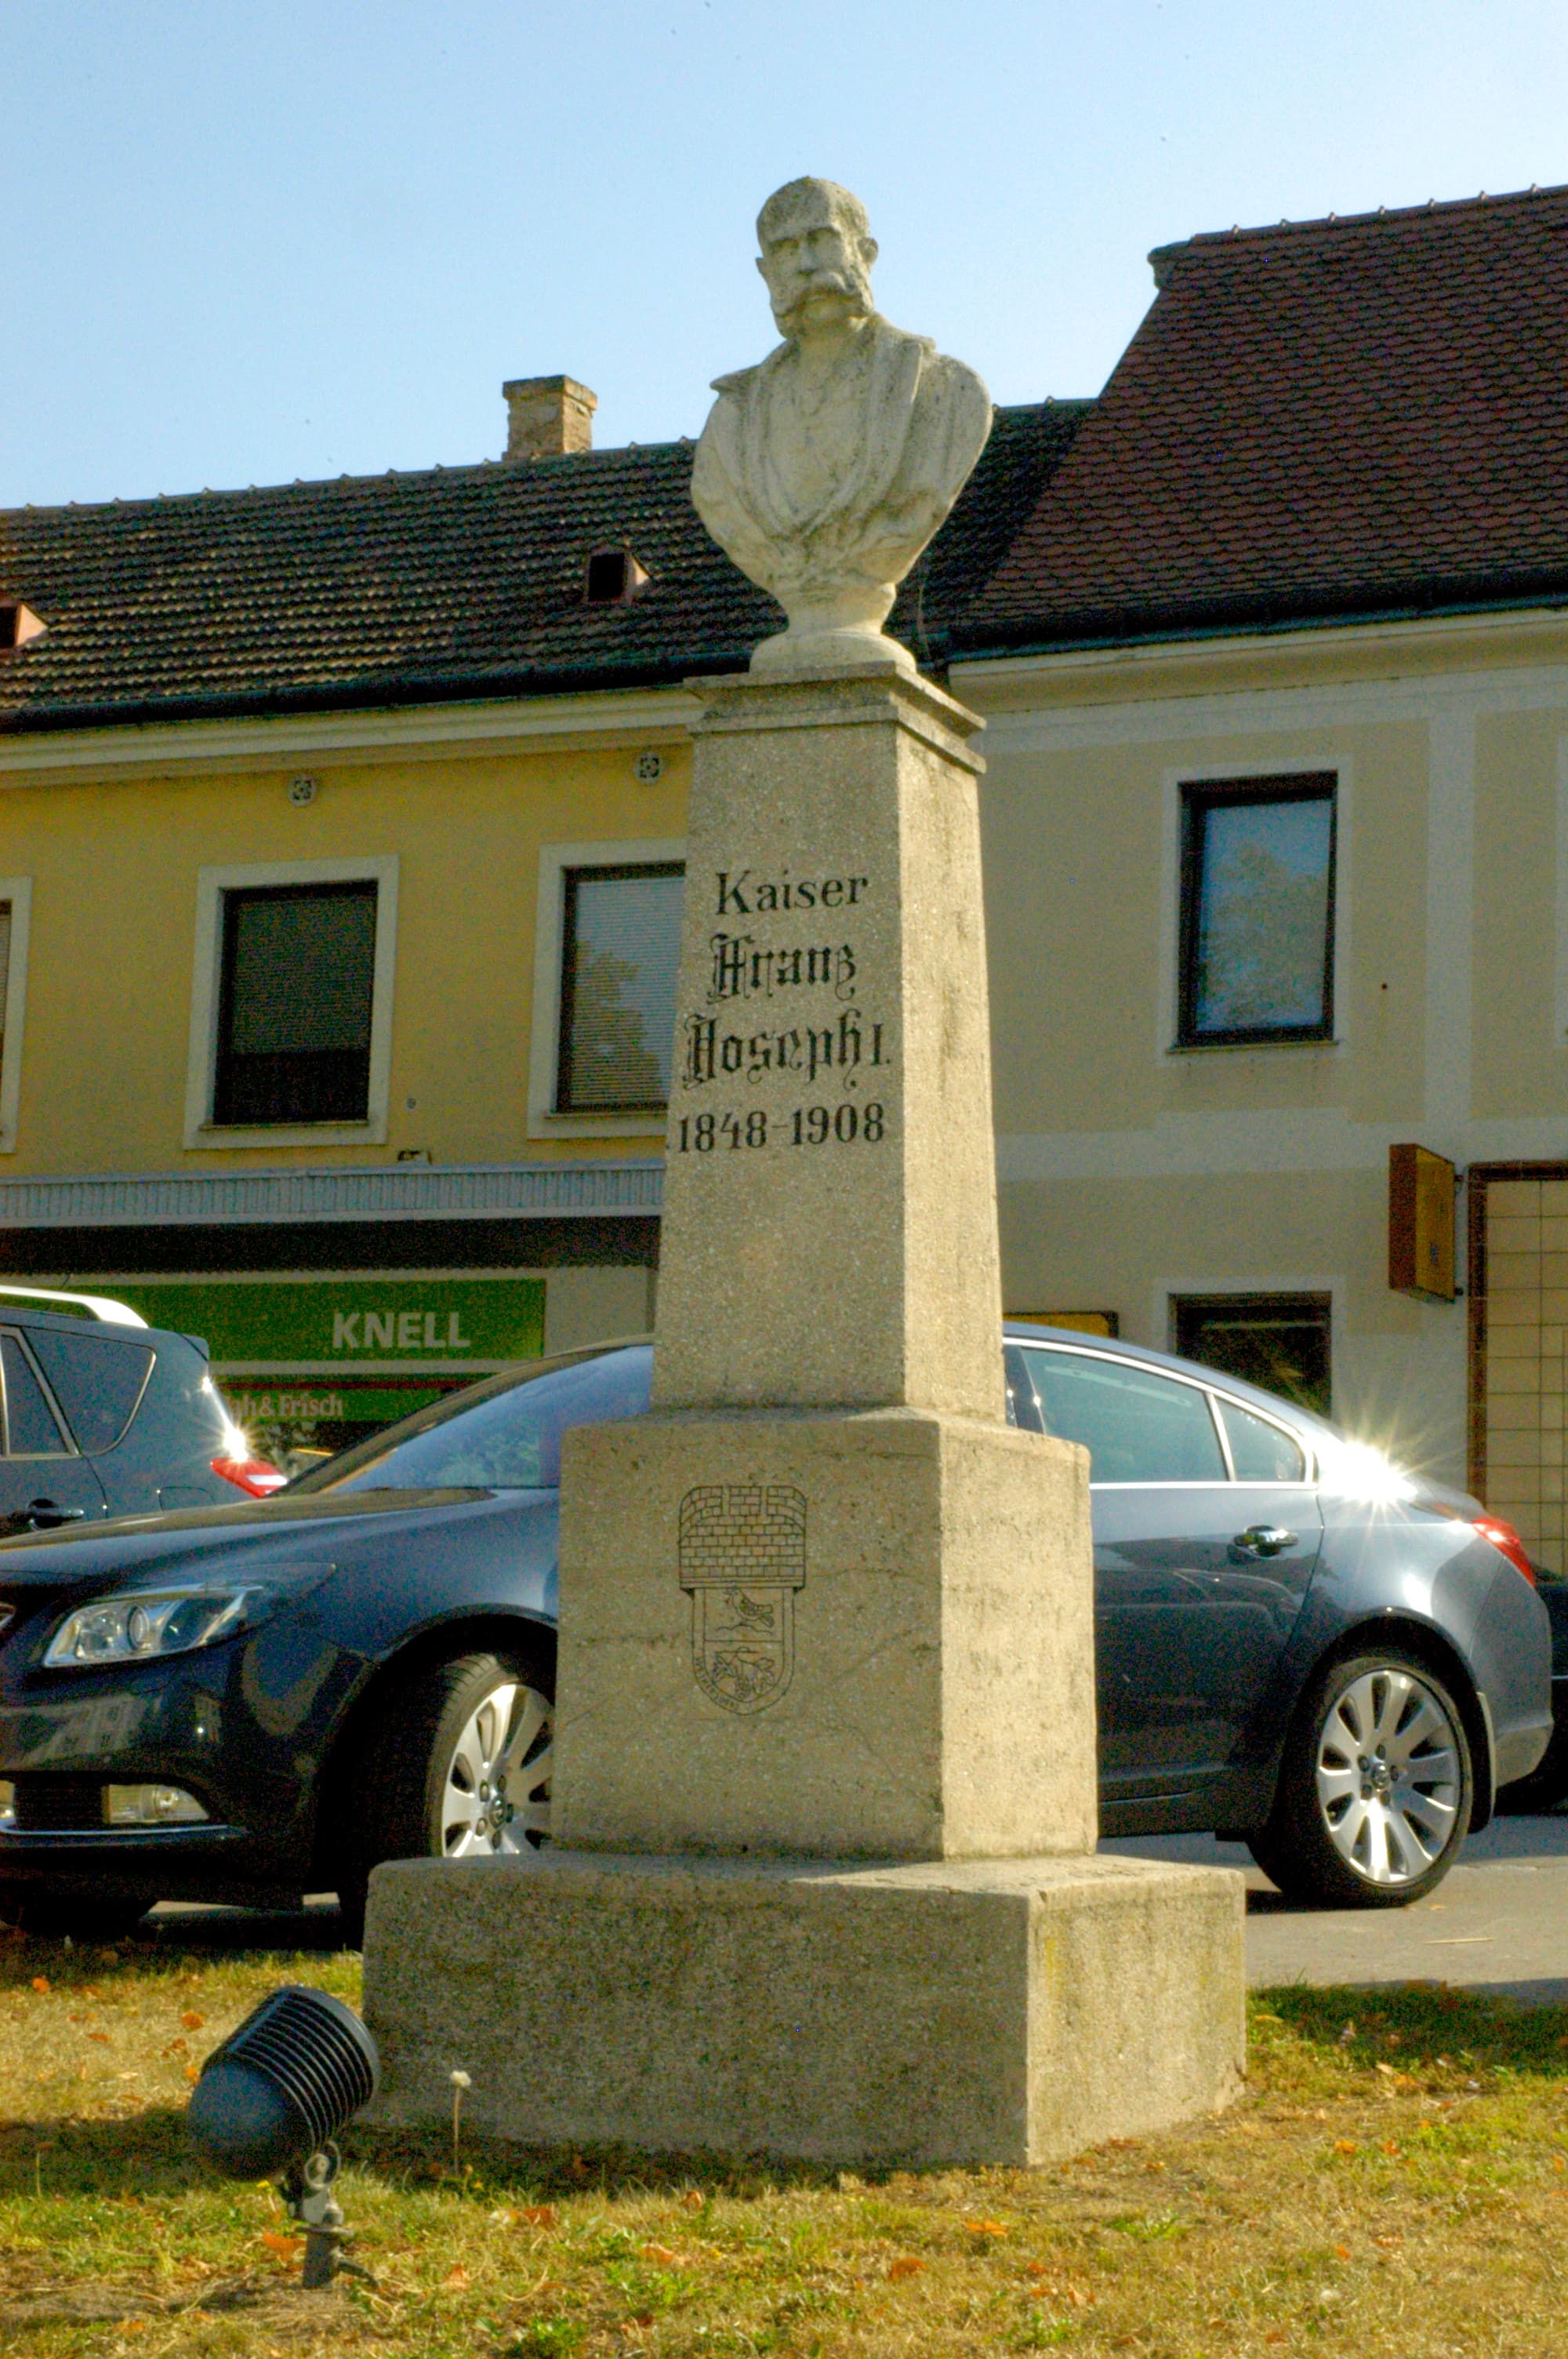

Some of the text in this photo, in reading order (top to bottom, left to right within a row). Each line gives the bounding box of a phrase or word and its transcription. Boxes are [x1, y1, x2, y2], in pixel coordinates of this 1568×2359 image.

[715, 870, 869, 916] Kaiser
[706, 933, 857, 1005] Franz
[683, 1009, 862, 1091] Joseph
[332, 1311, 470, 1350] KNELL
